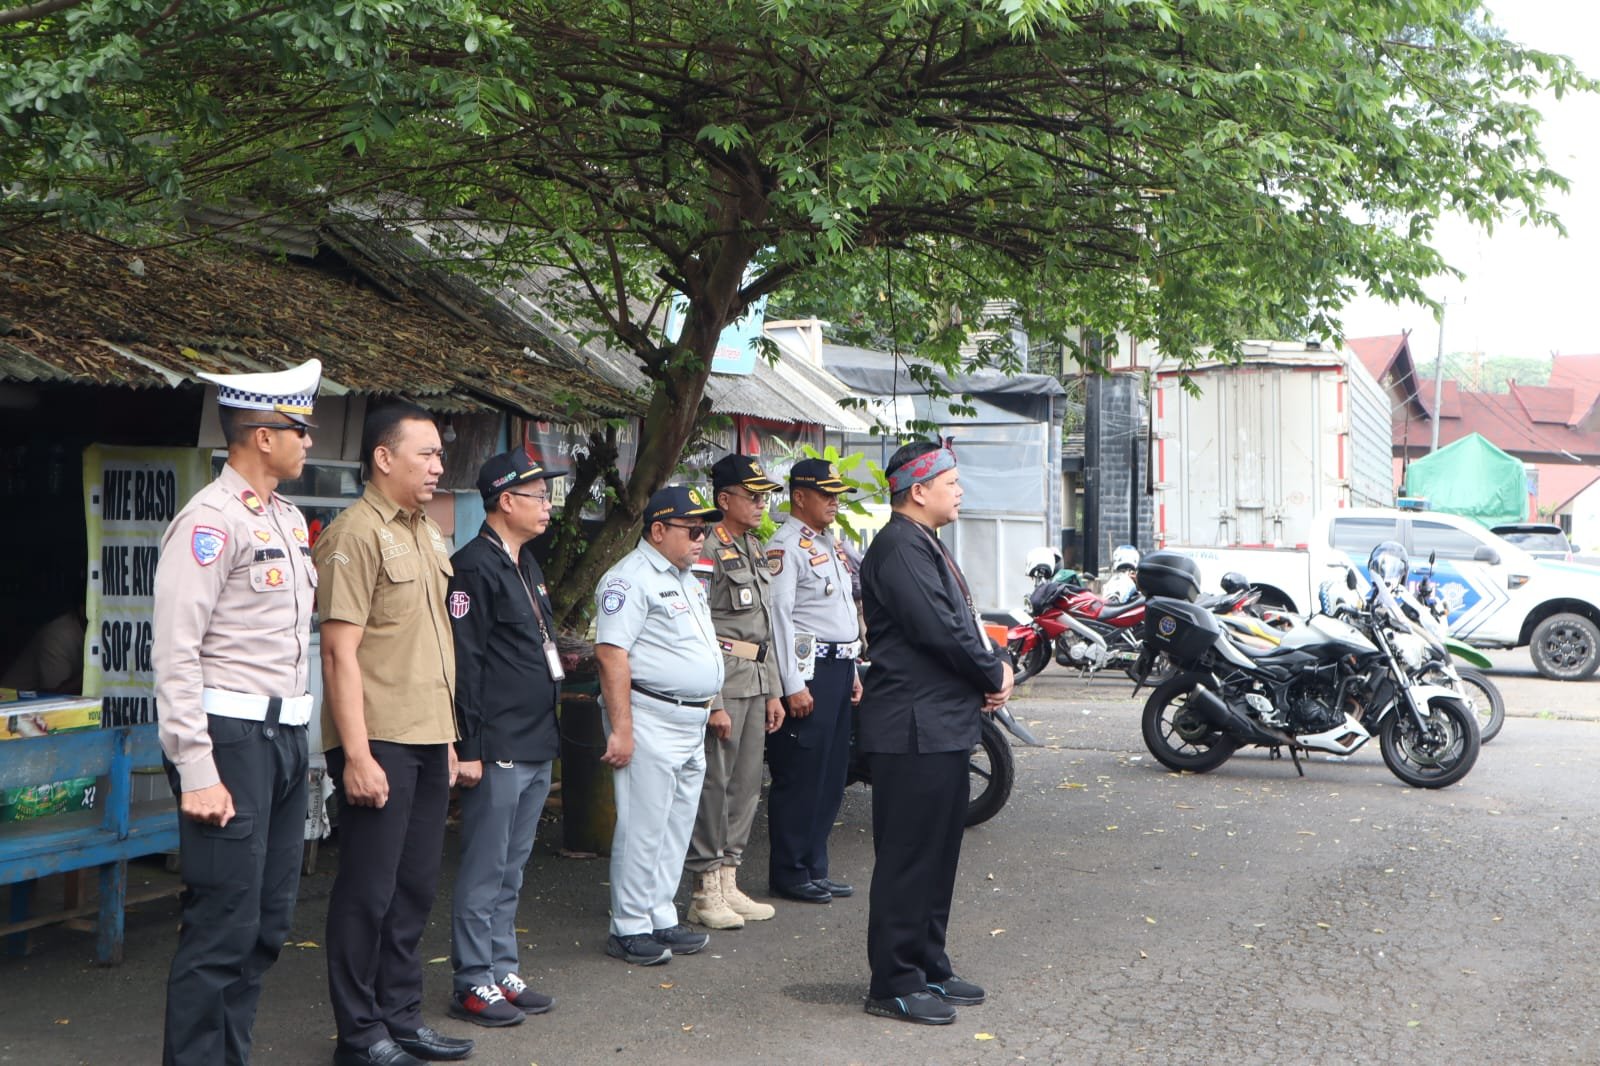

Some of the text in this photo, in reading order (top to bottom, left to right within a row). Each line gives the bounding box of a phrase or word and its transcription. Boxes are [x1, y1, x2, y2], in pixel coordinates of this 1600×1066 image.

[102, 469, 176, 522] MIE BASO
[101, 545, 130, 597] MIE
[102, 620, 155, 672] SOP IG
